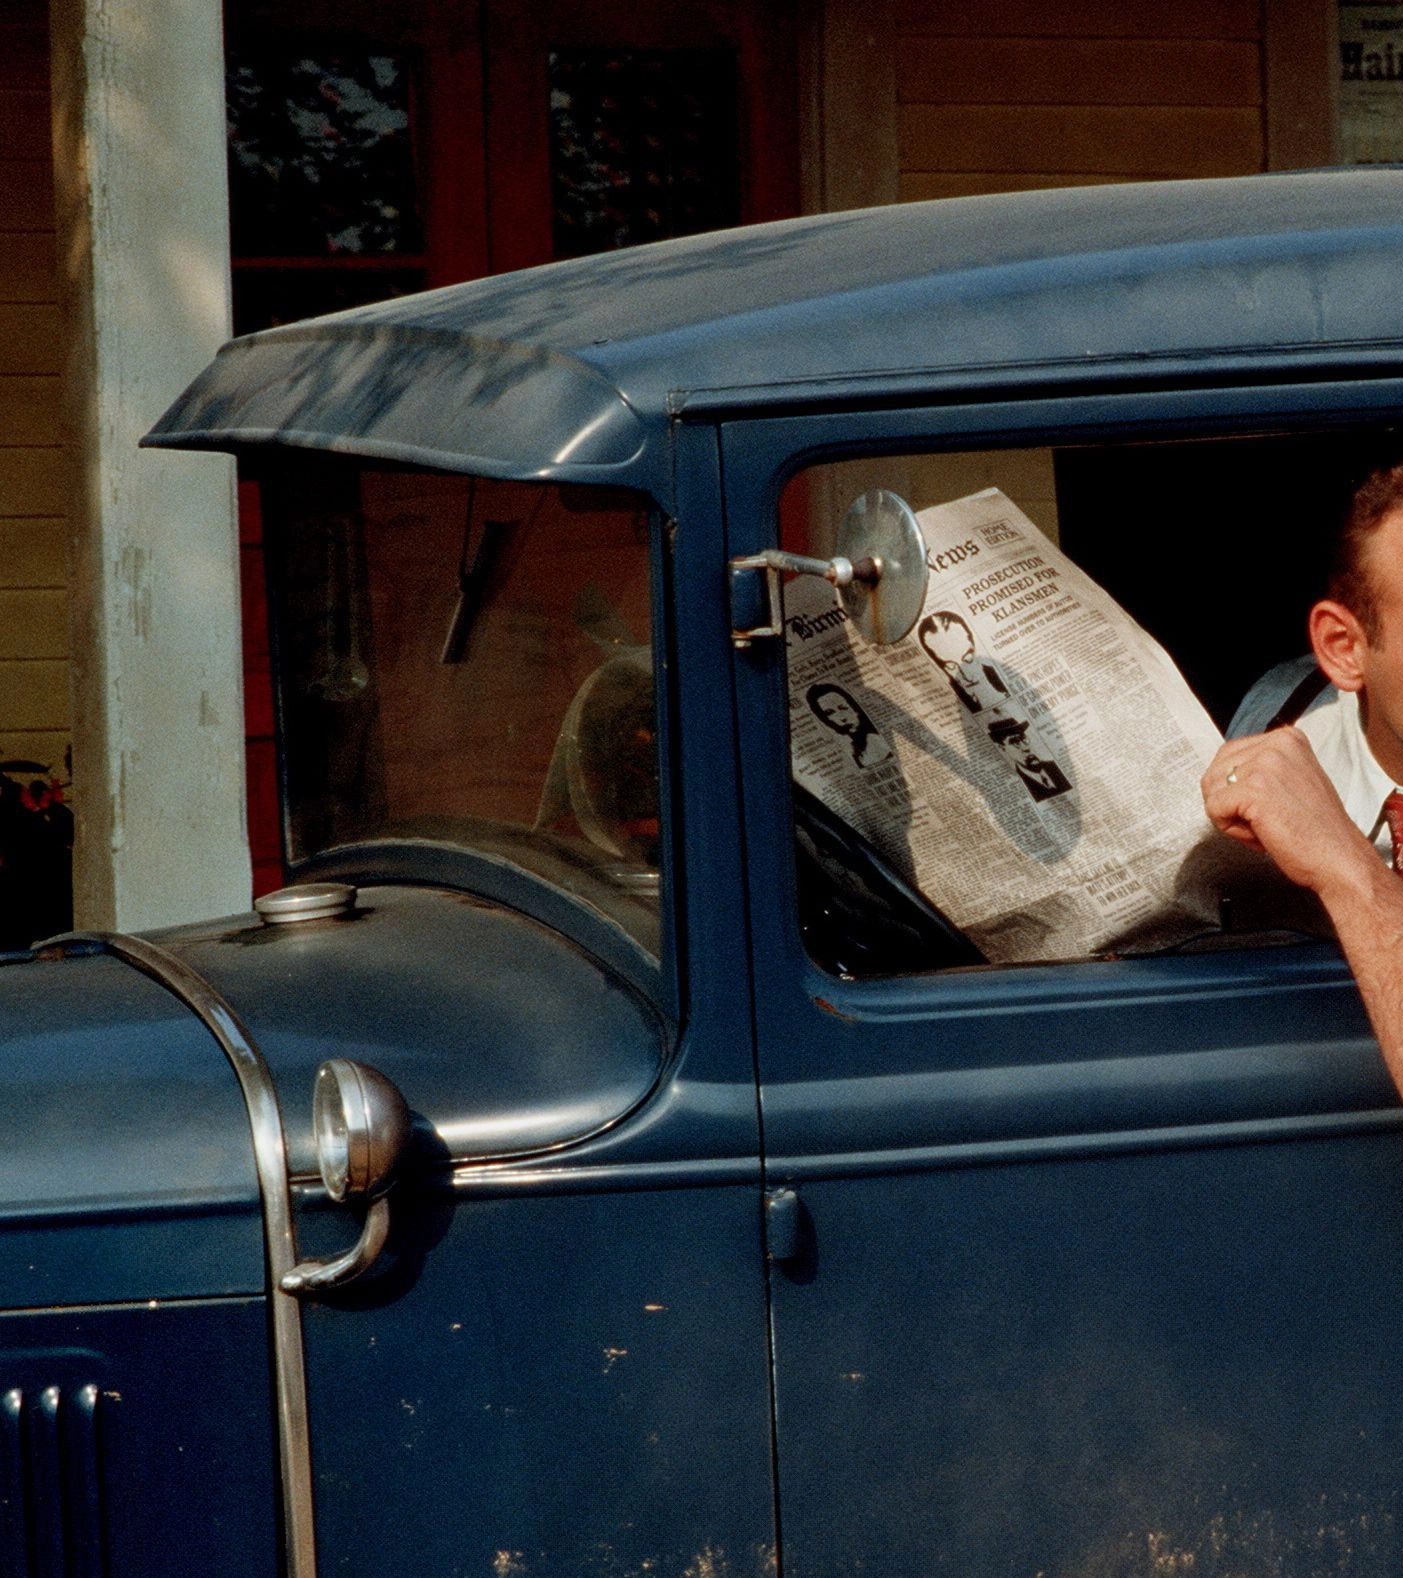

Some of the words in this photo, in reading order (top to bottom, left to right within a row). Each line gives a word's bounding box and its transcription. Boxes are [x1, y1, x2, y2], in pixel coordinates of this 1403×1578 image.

[980, 523, 1009, 536] HOME
[962, 556, 1046, 600] PROSECUTION
[968, 576, 1035, 616] PROMISED
[1033, 567, 1061, 582] FOR
[785, 600, 849, 641] Birmi
[990, 623, 1017, 641] LICENSE
[1016, 607, 1046, 626] NUMBERS
[1045, 602, 1054, 612] OF
[991, 582, 1059, 623] KLANSMEN
[993, 633, 1019, 652] TURNED
[1018, 623, 1037, 638] OVER
[1035, 618, 1046, 628] TO
